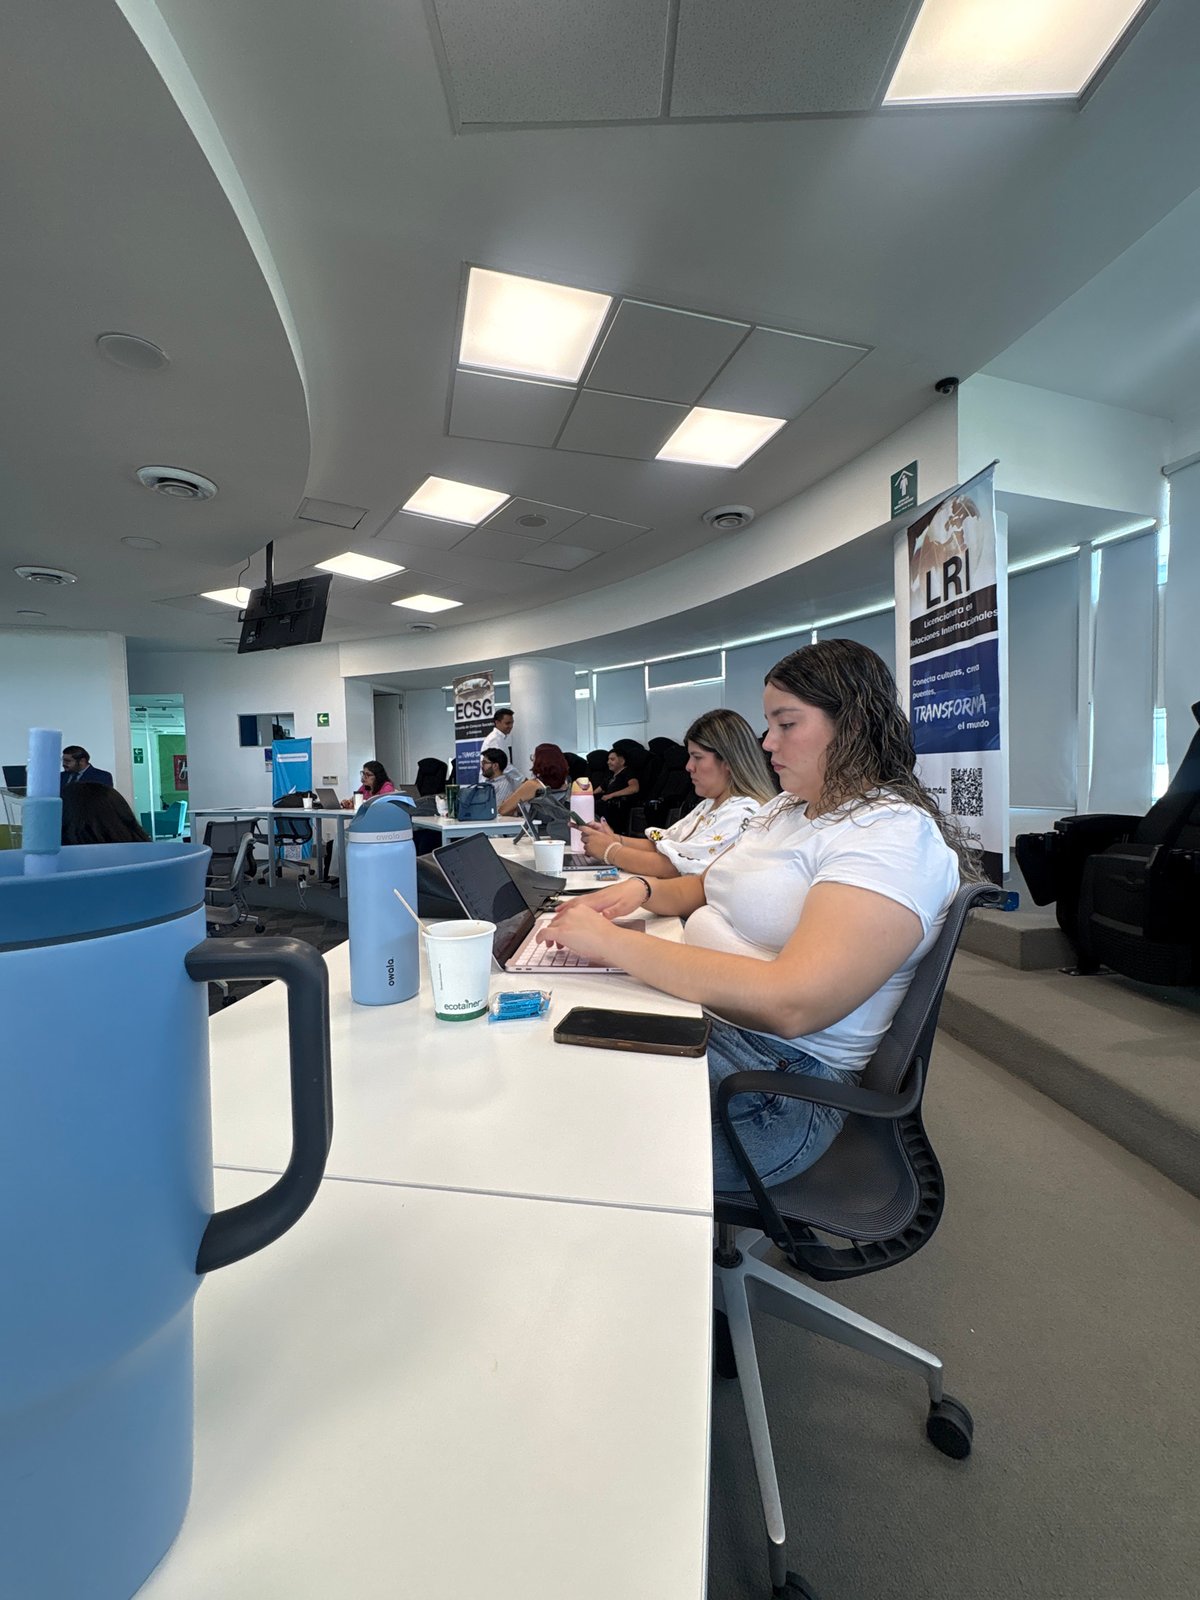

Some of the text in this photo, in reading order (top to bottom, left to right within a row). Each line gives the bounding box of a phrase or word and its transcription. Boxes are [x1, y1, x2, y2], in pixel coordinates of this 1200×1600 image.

[926, 549, 970, 609] LRI
[923, 606, 964, 628] Licenciatura
[912, 675, 936, 687] Conecta
[455, 699, 493, 720] ECSG
[914, 693, 986, 724] TRANSFORMA
[957, 719, 990, 730] el mundo
[376, 833, 401, 841] owala
[386, 958, 395, 987] owala
[444, 999, 480, 1010] ecotainer
